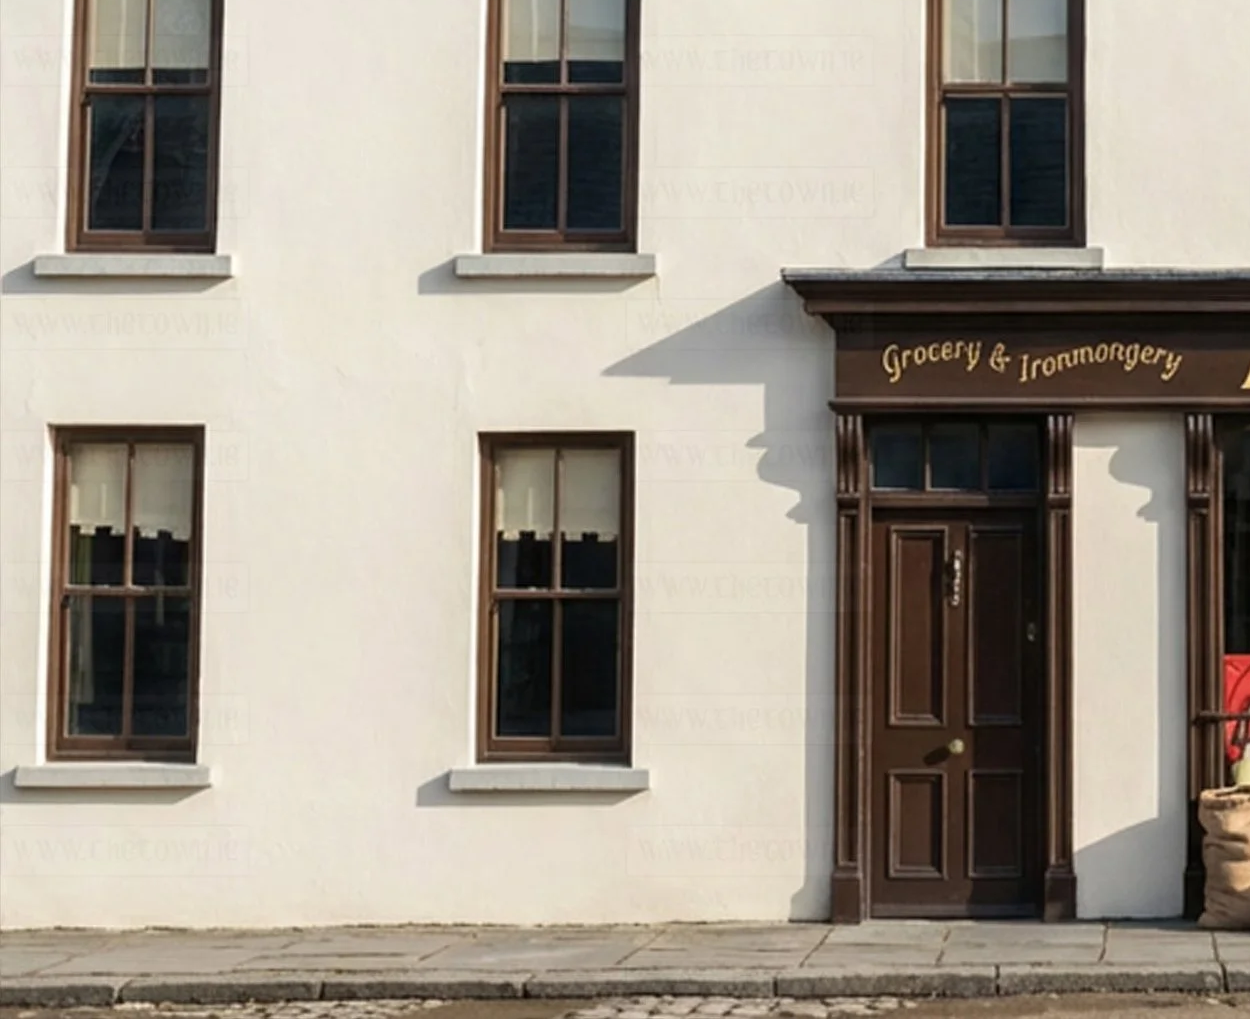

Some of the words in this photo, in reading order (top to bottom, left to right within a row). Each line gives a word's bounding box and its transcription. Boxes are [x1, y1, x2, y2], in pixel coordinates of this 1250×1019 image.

[882, 340, 981, 383] Grocery
[989, 343, 1011, 373] &
[1019, 342, 1183, 381] Ironmongery
